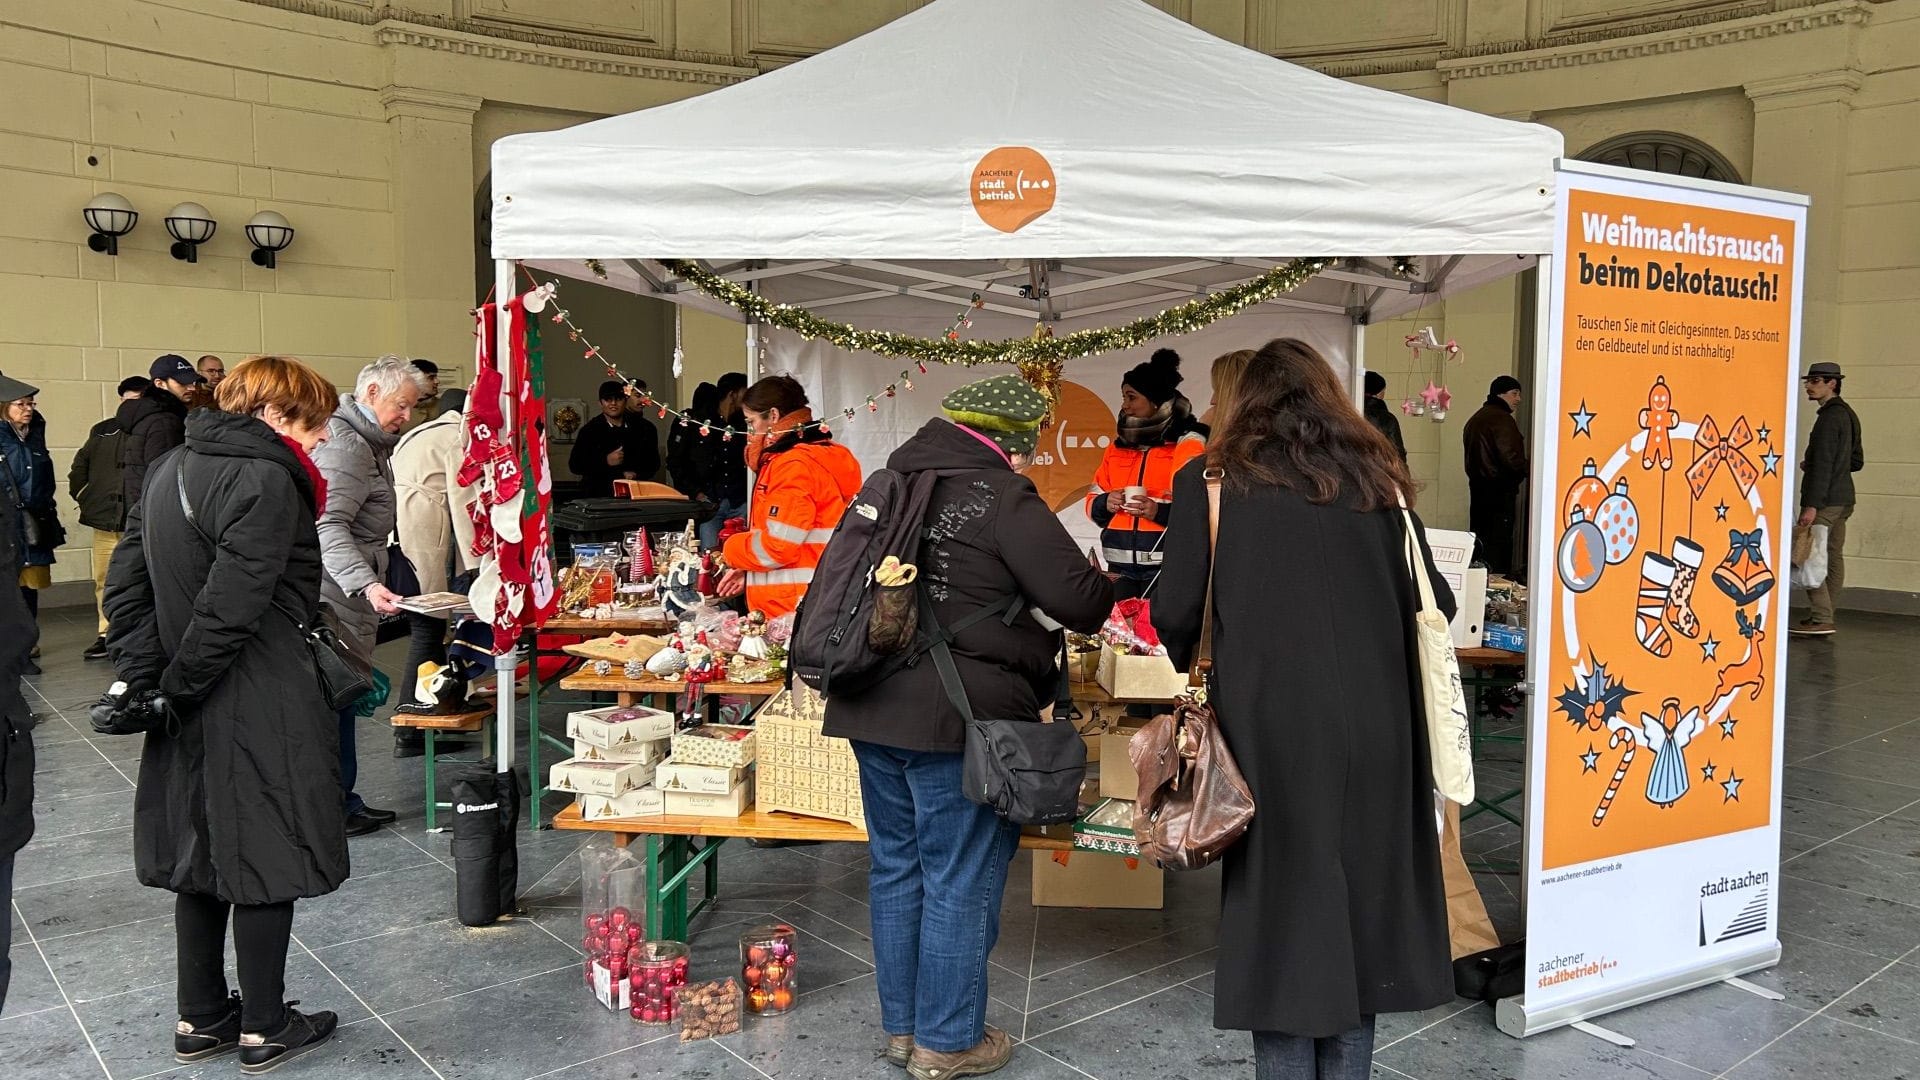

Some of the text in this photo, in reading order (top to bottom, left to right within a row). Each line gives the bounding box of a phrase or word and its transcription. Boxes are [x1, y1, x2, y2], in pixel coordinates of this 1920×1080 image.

[979, 179, 1006, 189] stadt
[979, 190, 1016, 200] betrieb
[1581, 211, 1784, 265] Weihnachtsrausch
[1578, 252, 1779, 303] beim Dekotausch!
[1577, 314, 1780, 342] Tauschen Sie mit Gleichgesinnten. Das schont
[1576, 336, 1735, 362] den Geldbeutel und ist nachhaltig!
[473, 424, 491, 441] 13
[498, 460, 517, 480] 23
[1540, 861, 1623, 887] www.aachener-stadtbetrieb.de
[1700, 870, 1769, 898] stadt aachen
[1538, 952, 1585, 973] aachener
[1538, 961, 1599, 989] stadtbetrieb
